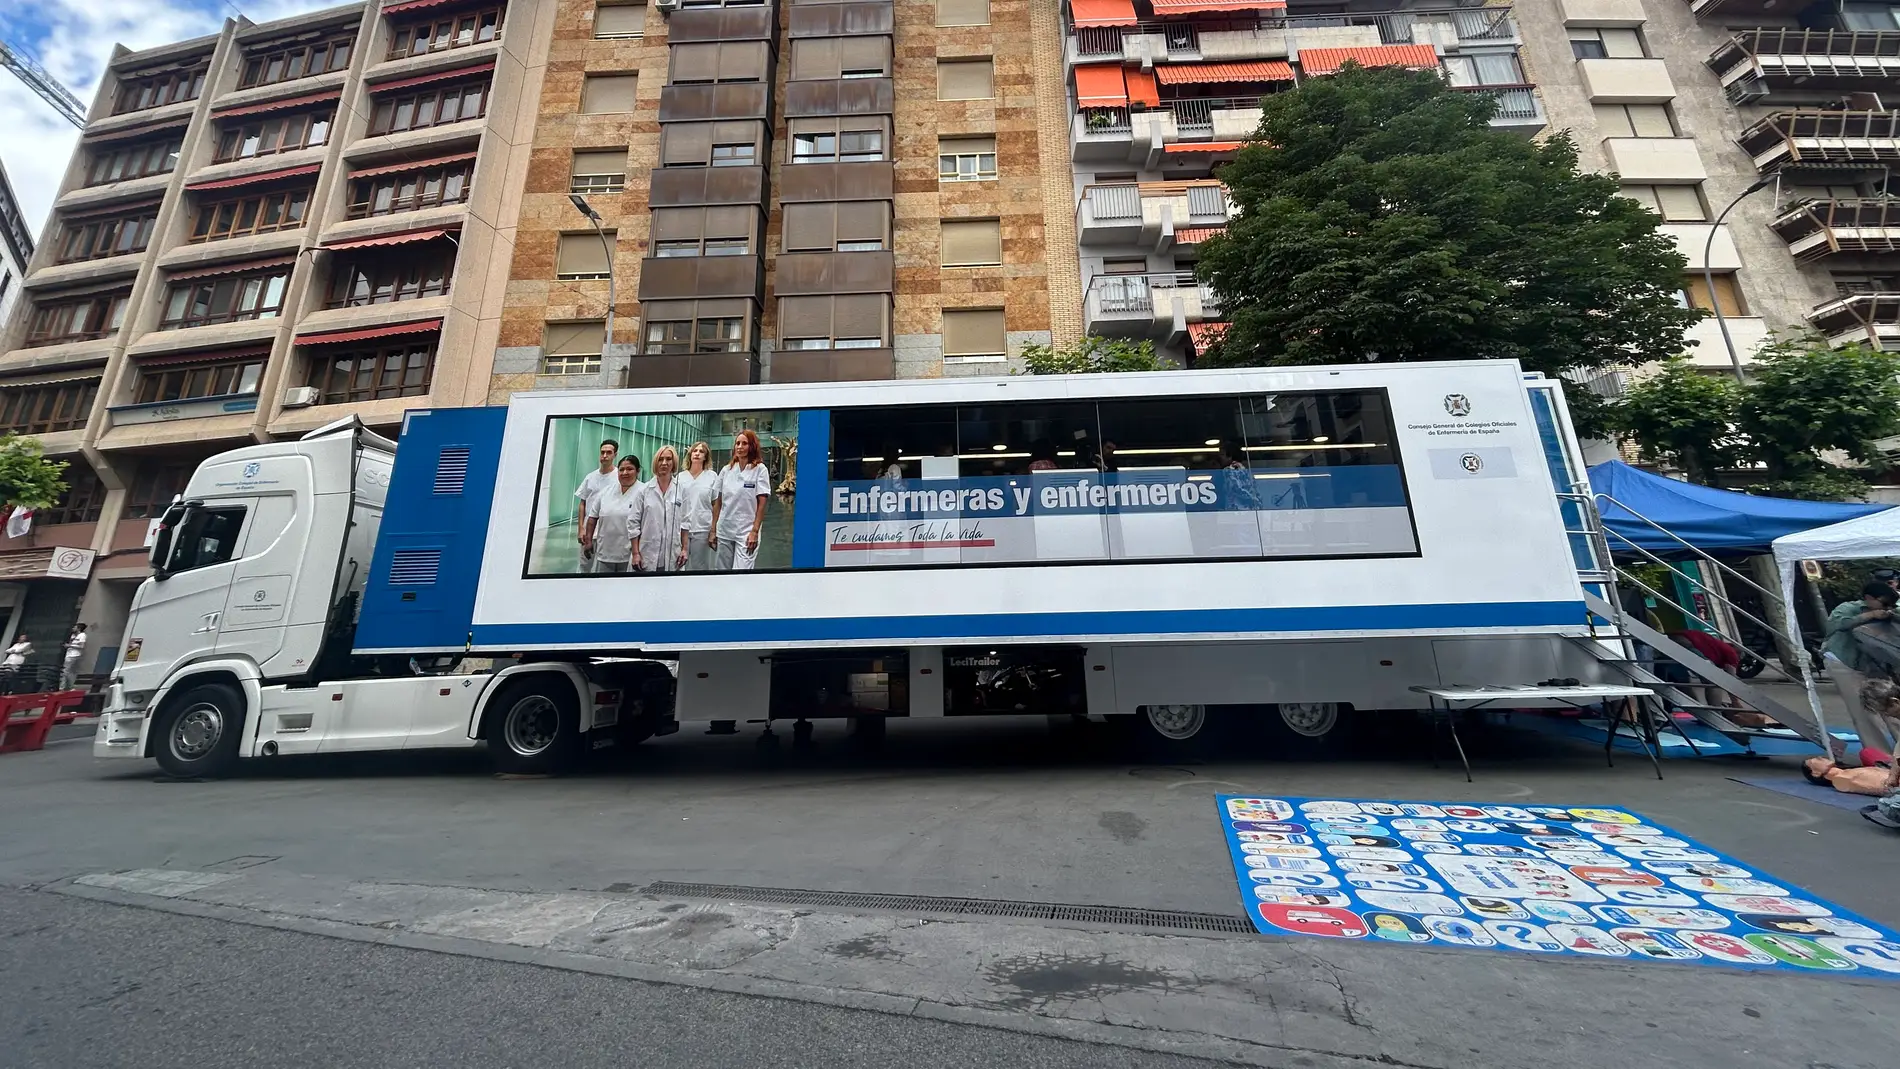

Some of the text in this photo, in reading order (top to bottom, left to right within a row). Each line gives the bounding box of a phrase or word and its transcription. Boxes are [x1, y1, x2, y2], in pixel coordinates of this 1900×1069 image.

[832, 479, 1218, 515] Enfermeras y enfermeros
[832, 520, 984, 545] Te cuidamos Toda la vida
[950, 657, 1000, 666] LeciTrailer
